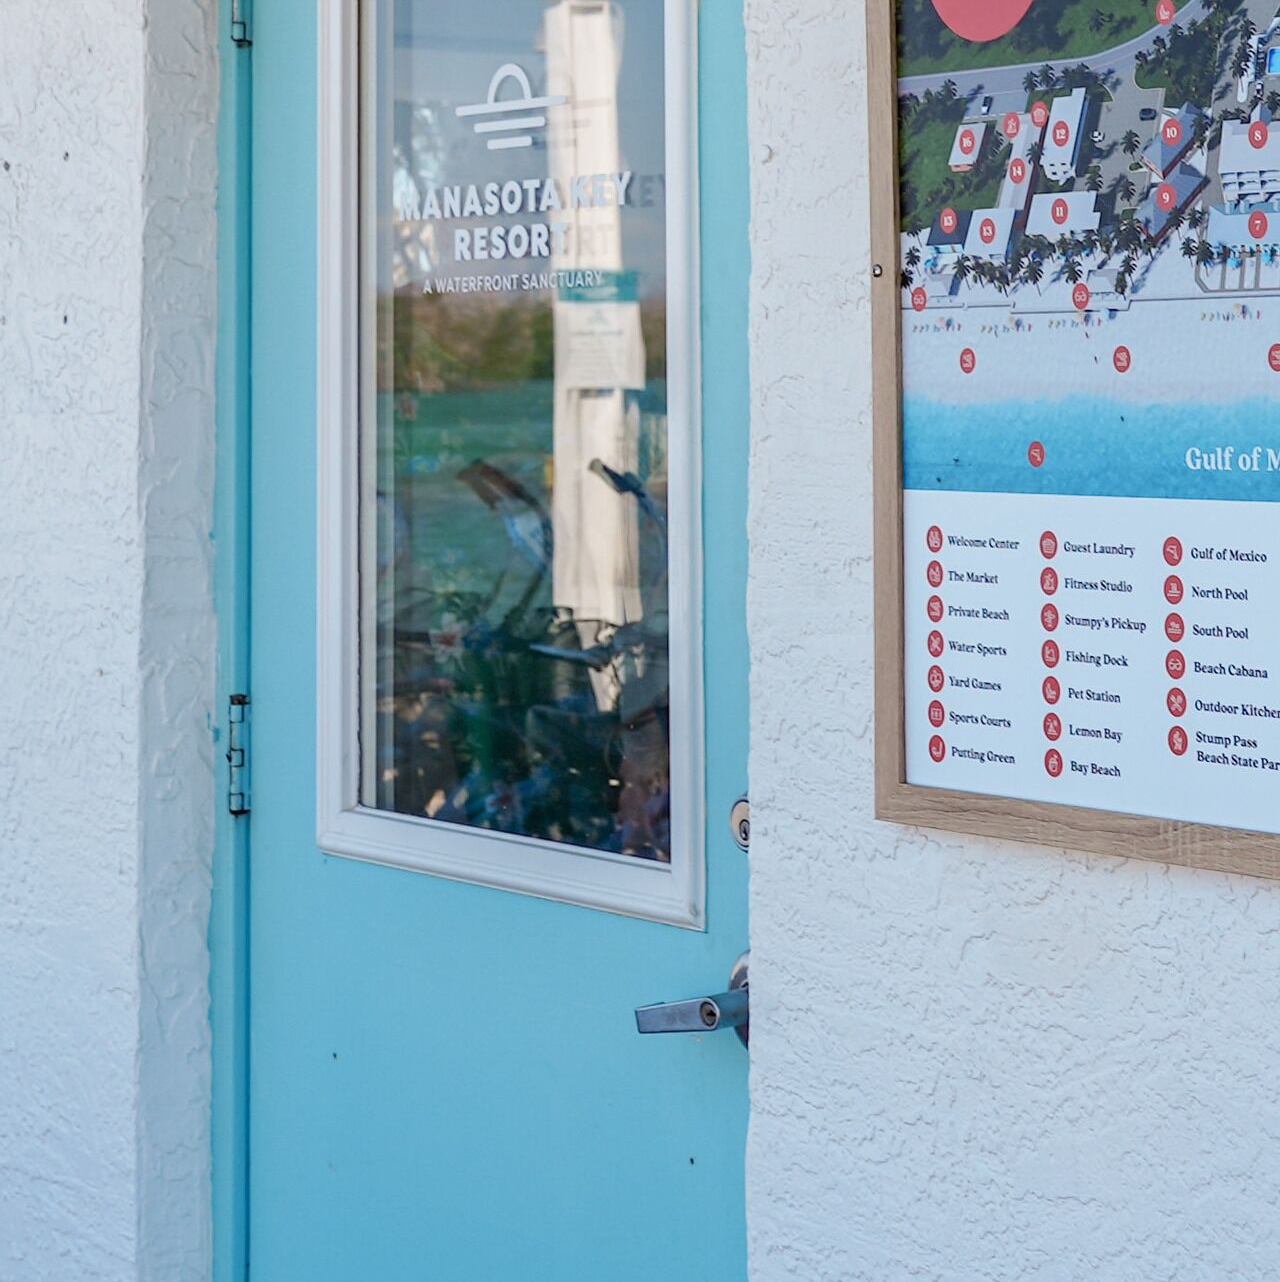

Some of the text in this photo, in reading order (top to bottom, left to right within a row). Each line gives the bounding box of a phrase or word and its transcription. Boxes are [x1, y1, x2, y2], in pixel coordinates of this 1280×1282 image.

[399, 171, 632, 222] MANASOTA KEY
[1254, 219, 1261, 231] 7
[454, 222, 569, 262] RESORT
[423, 280, 433, 295] A
[433, 273, 519, 295] WATERFRONT
[522, 270, 603, 291] SANCTUARY
[1185, 446, 1233, 471] Gulf
[1237, 446, 1263, 471] of
[947, 535, 1019, 549] Welcome Center
[1063, 541, 1135, 558] Guest Laundry
[1190, 547, 1267, 562] Gulf of Mexico
[947, 570, 998, 584] The Market
[1064, 577, 1132, 592] Fitness Studio
[1191, 585, 1248, 600] North Pool
[948, 605, 1009, 620] Private Beach
[1064, 613, 1146, 633] Stumpy's Pickup
[1192, 623, 1248, 639] South Pool
[948, 640, 1006, 657] Water Sports
[1065, 650, 1128, 667] Fishing Dock
[1193, 661, 1268, 678] Beach Cabana
[948, 675, 1001, 691] Yard Games
[1068, 687, 1120, 703] Pet Station
[1194, 699, 1239, 714] Outdoor
[949, 710, 1011, 728] Sports Courts
[1068, 723, 1122, 743] Lemon Bay
[1195, 730, 1257, 748] Stump Pass
[951, 745, 1015, 764] Putting Green
[1196, 750, 1229, 765] Beach
[1231, 754, 1258, 768] State
[1070, 760, 1121, 777] Bay Beach
